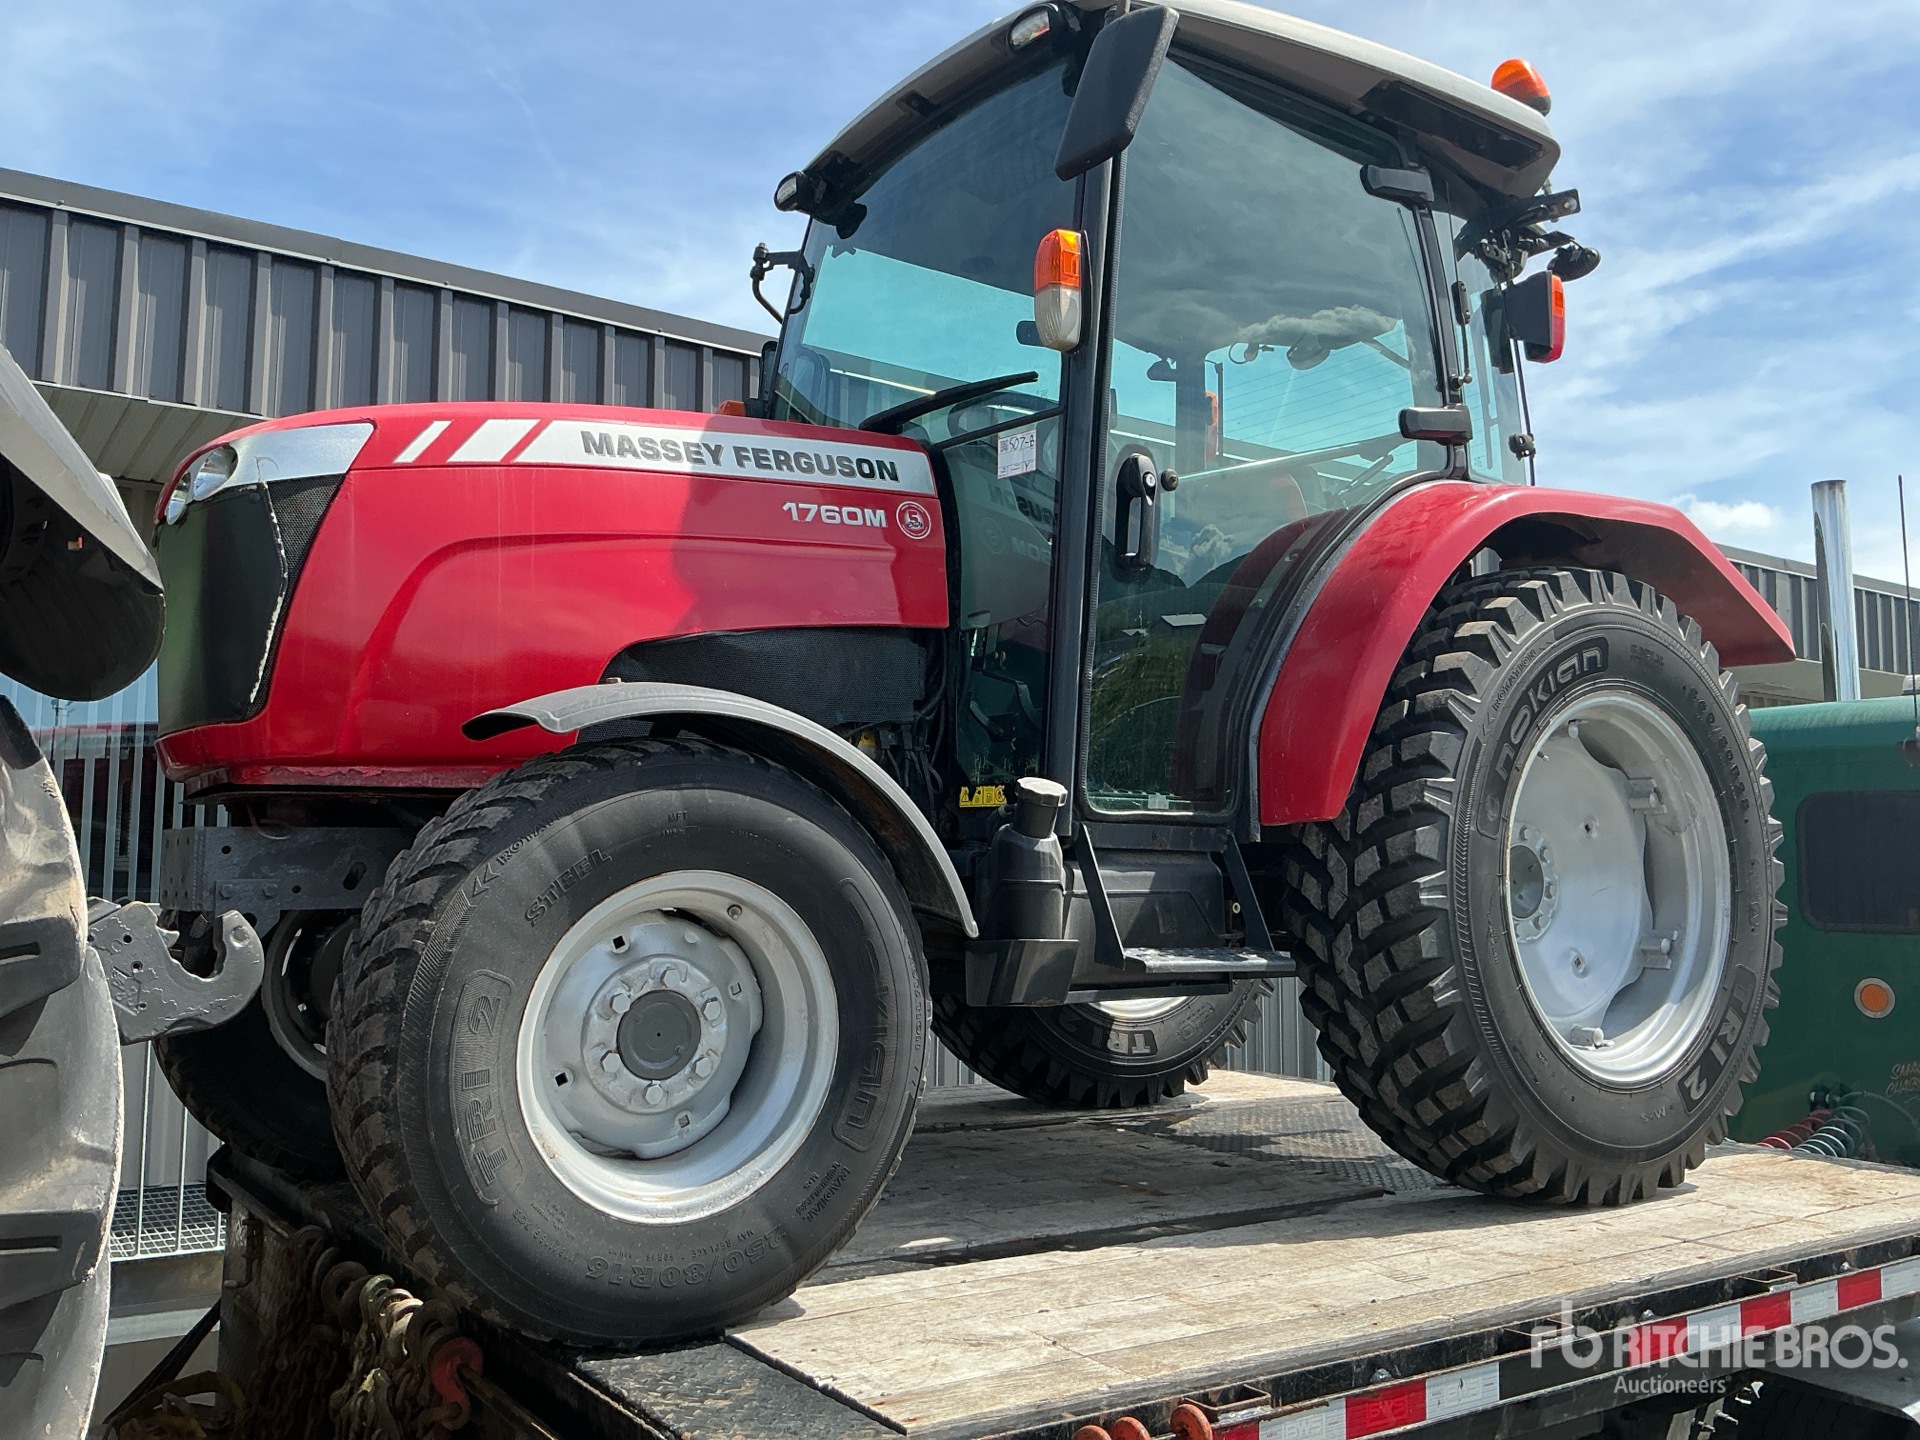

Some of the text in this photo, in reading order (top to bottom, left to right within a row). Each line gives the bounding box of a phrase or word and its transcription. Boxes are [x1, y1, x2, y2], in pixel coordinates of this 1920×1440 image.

[580, 430, 901, 482] MASSEY FERGUSON
[782, 502, 887, 528] 1760M
[1492, 650, 1537, 711] ROTATION
[525, 849, 612, 927] STEEL
[1091, 1028, 1150, 1054] TRI
[1684, 984, 1749, 1100] TRI 2
[463, 995, 509, 1185] TRI 2
[804, 1166, 850, 1221] RADIAL
[585, 1224, 787, 1288] 250/80R16
